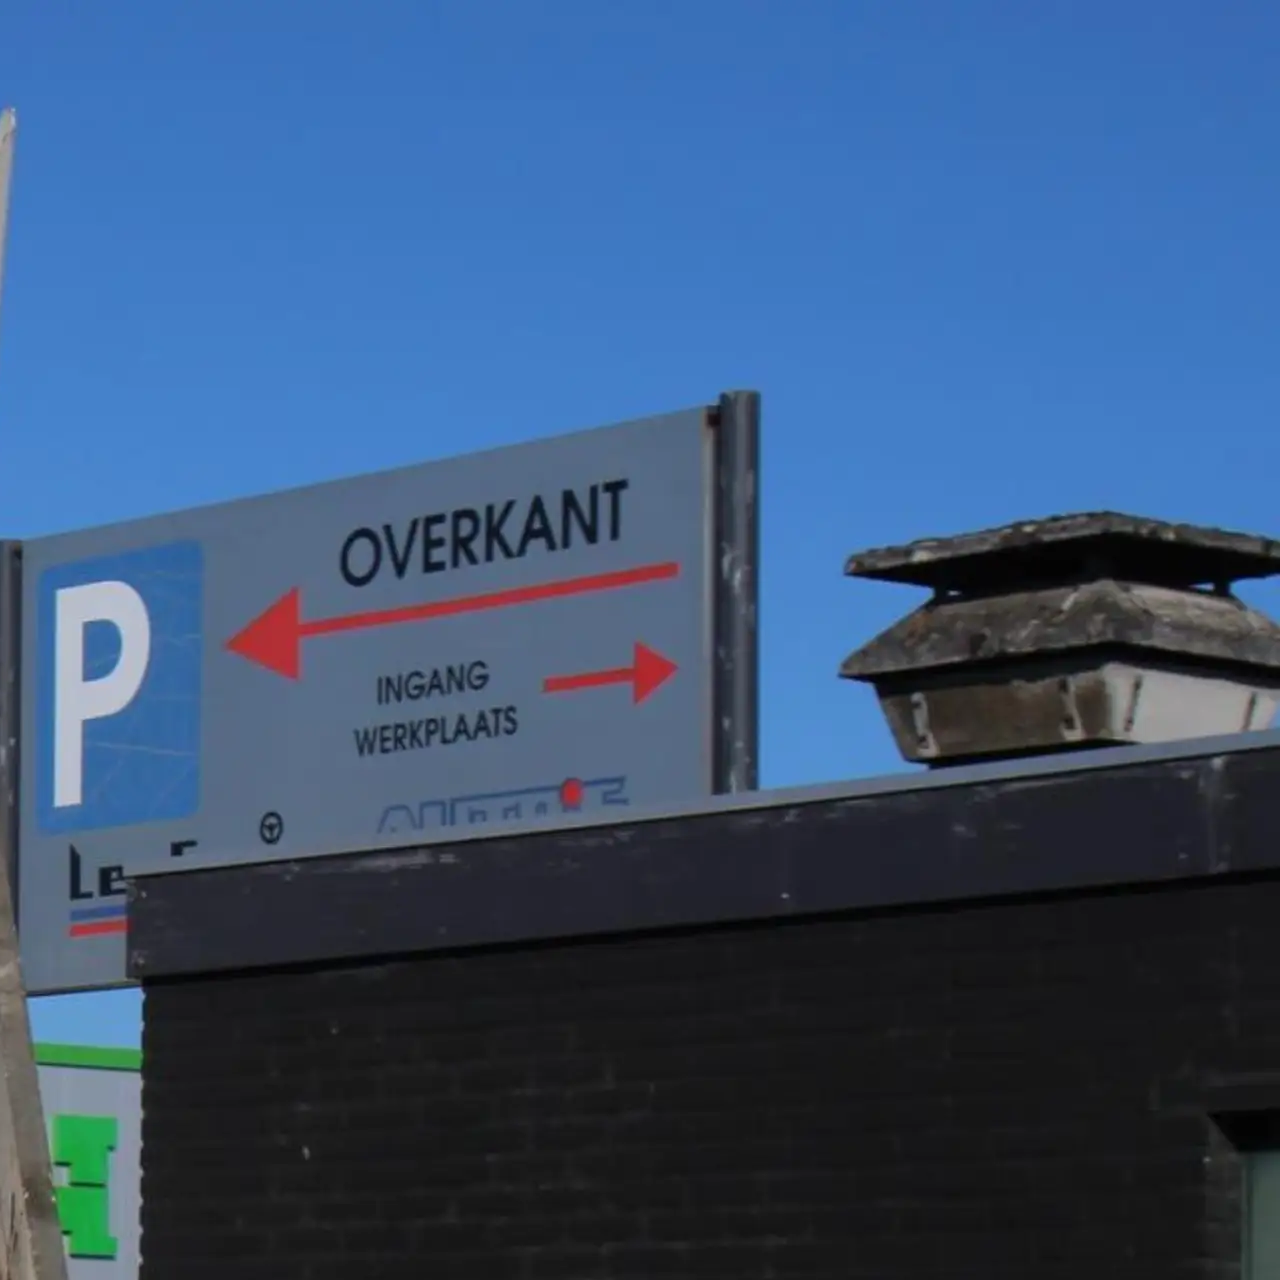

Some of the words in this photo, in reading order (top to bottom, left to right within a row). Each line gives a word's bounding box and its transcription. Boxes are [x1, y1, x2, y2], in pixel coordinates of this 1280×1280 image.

[341, 479, 630, 587] OVERKANT
[53, 580, 151, 809] P
[376, 660, 491, 705] INGANG
[353, 706, 519, 758] WERKPLAATS
